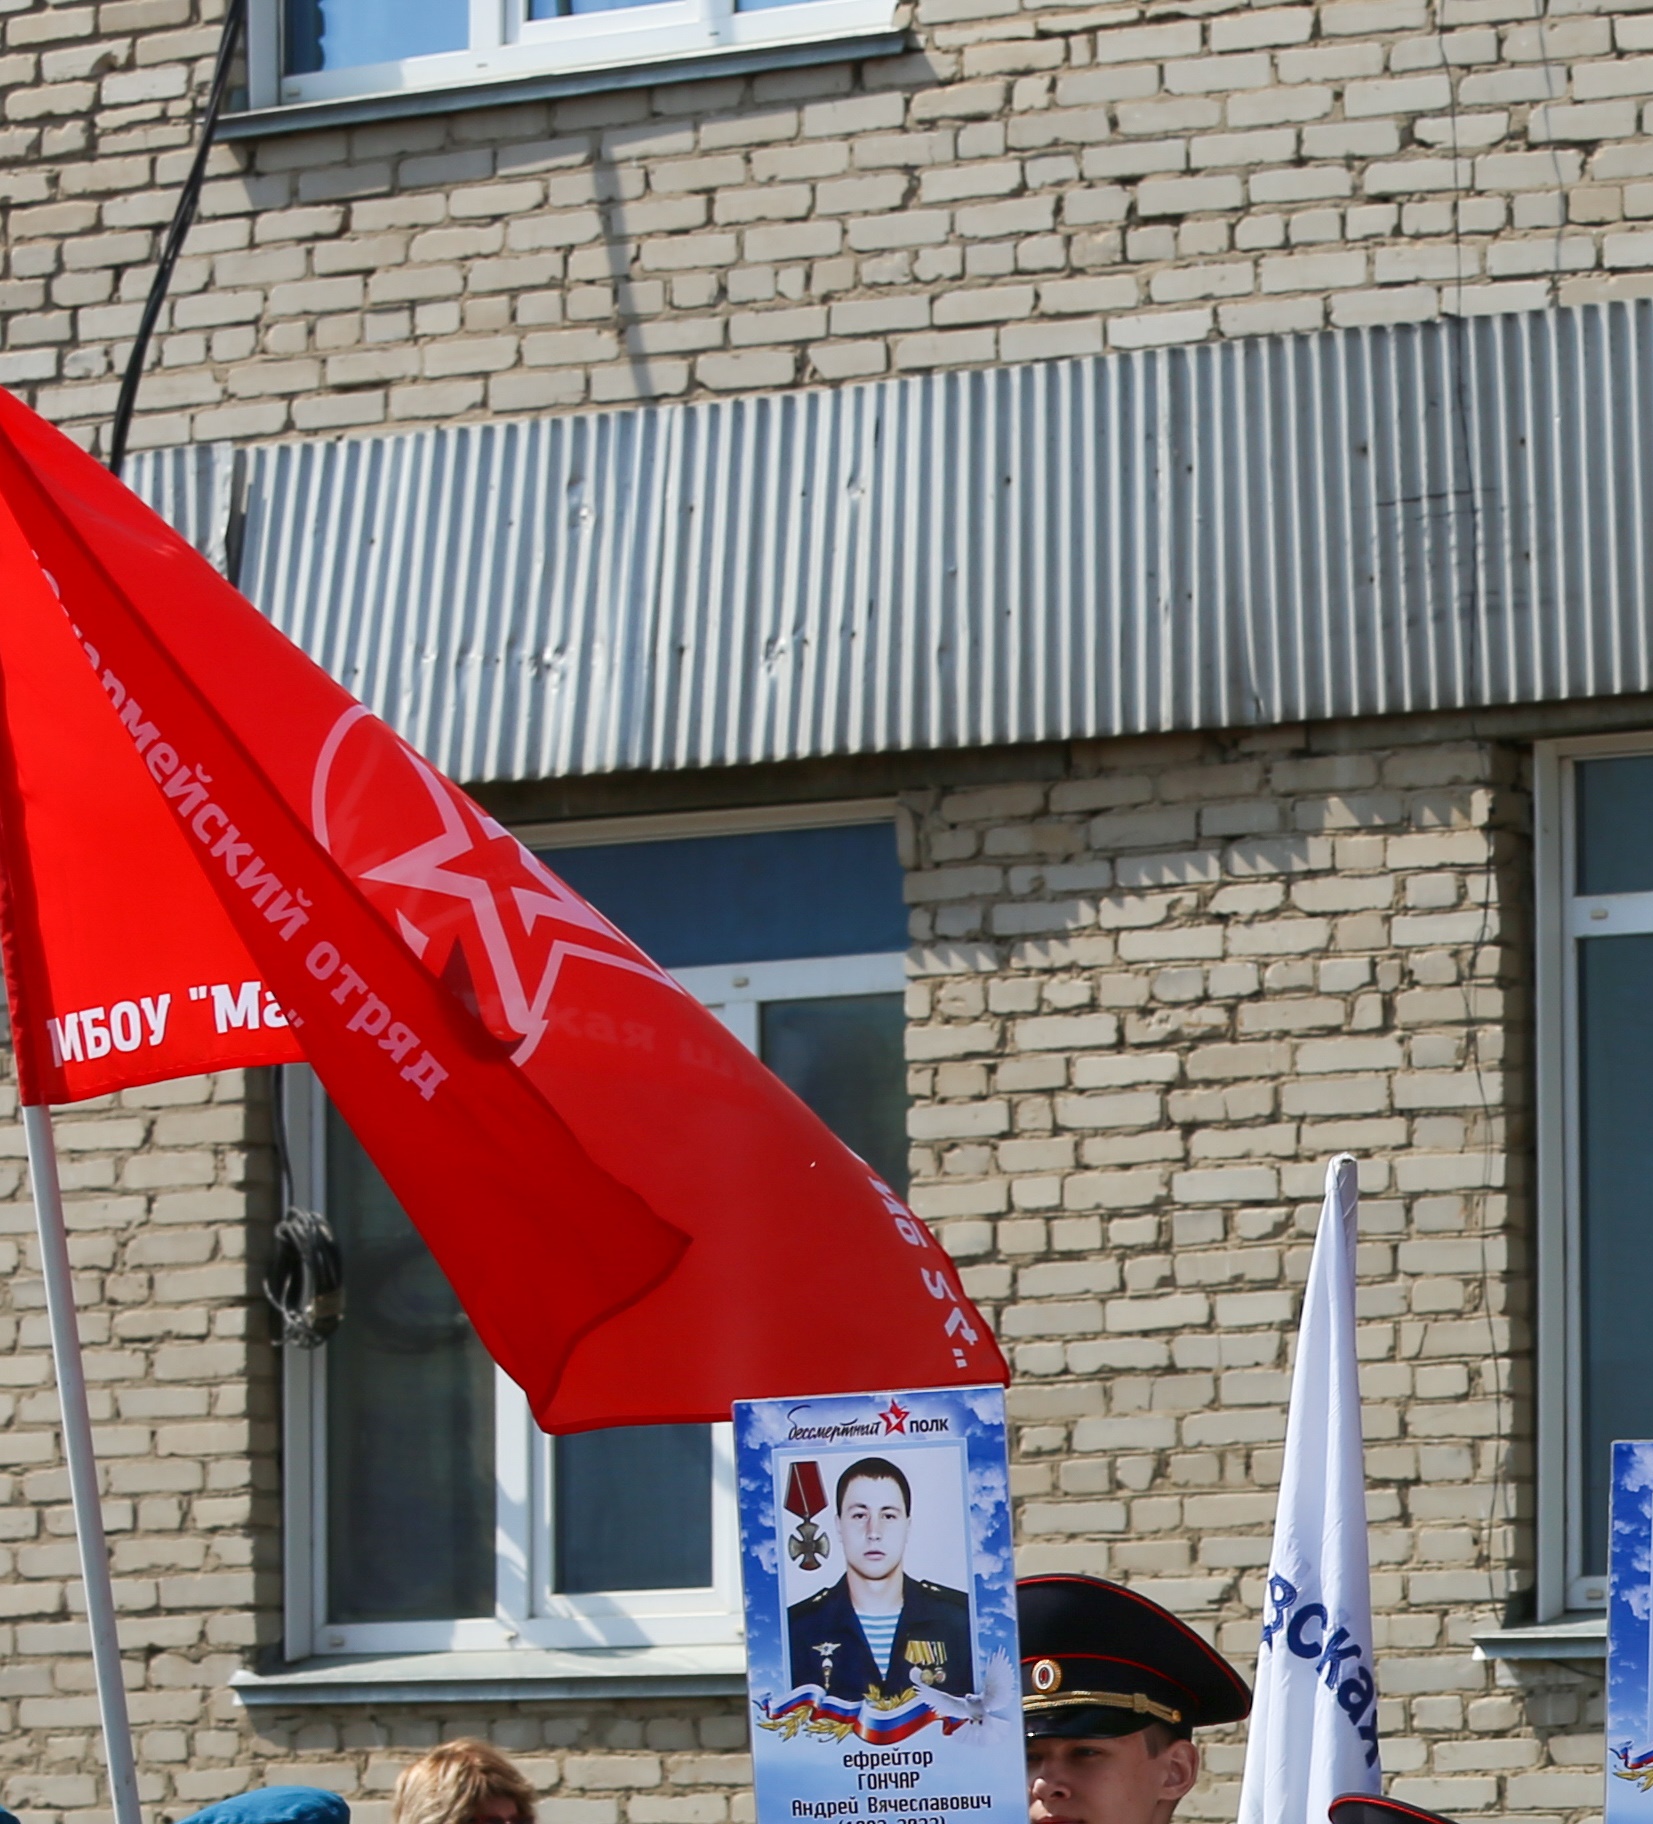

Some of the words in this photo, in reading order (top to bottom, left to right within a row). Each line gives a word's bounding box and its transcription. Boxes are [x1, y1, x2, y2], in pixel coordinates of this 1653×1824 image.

[47, 991, 171, 1067] МБОУ
[305, 941, 449, 1100] отряд
[787, 1404, 882, 1443] бессмертный
[843, 1747, 933, 1771] ефрейтор
[858, 1771, 920, 1791] ГОНЧАР
[792, 1797, 858, 1818] Андрей
[868, 1793, 992, 1815] Вячеславович
